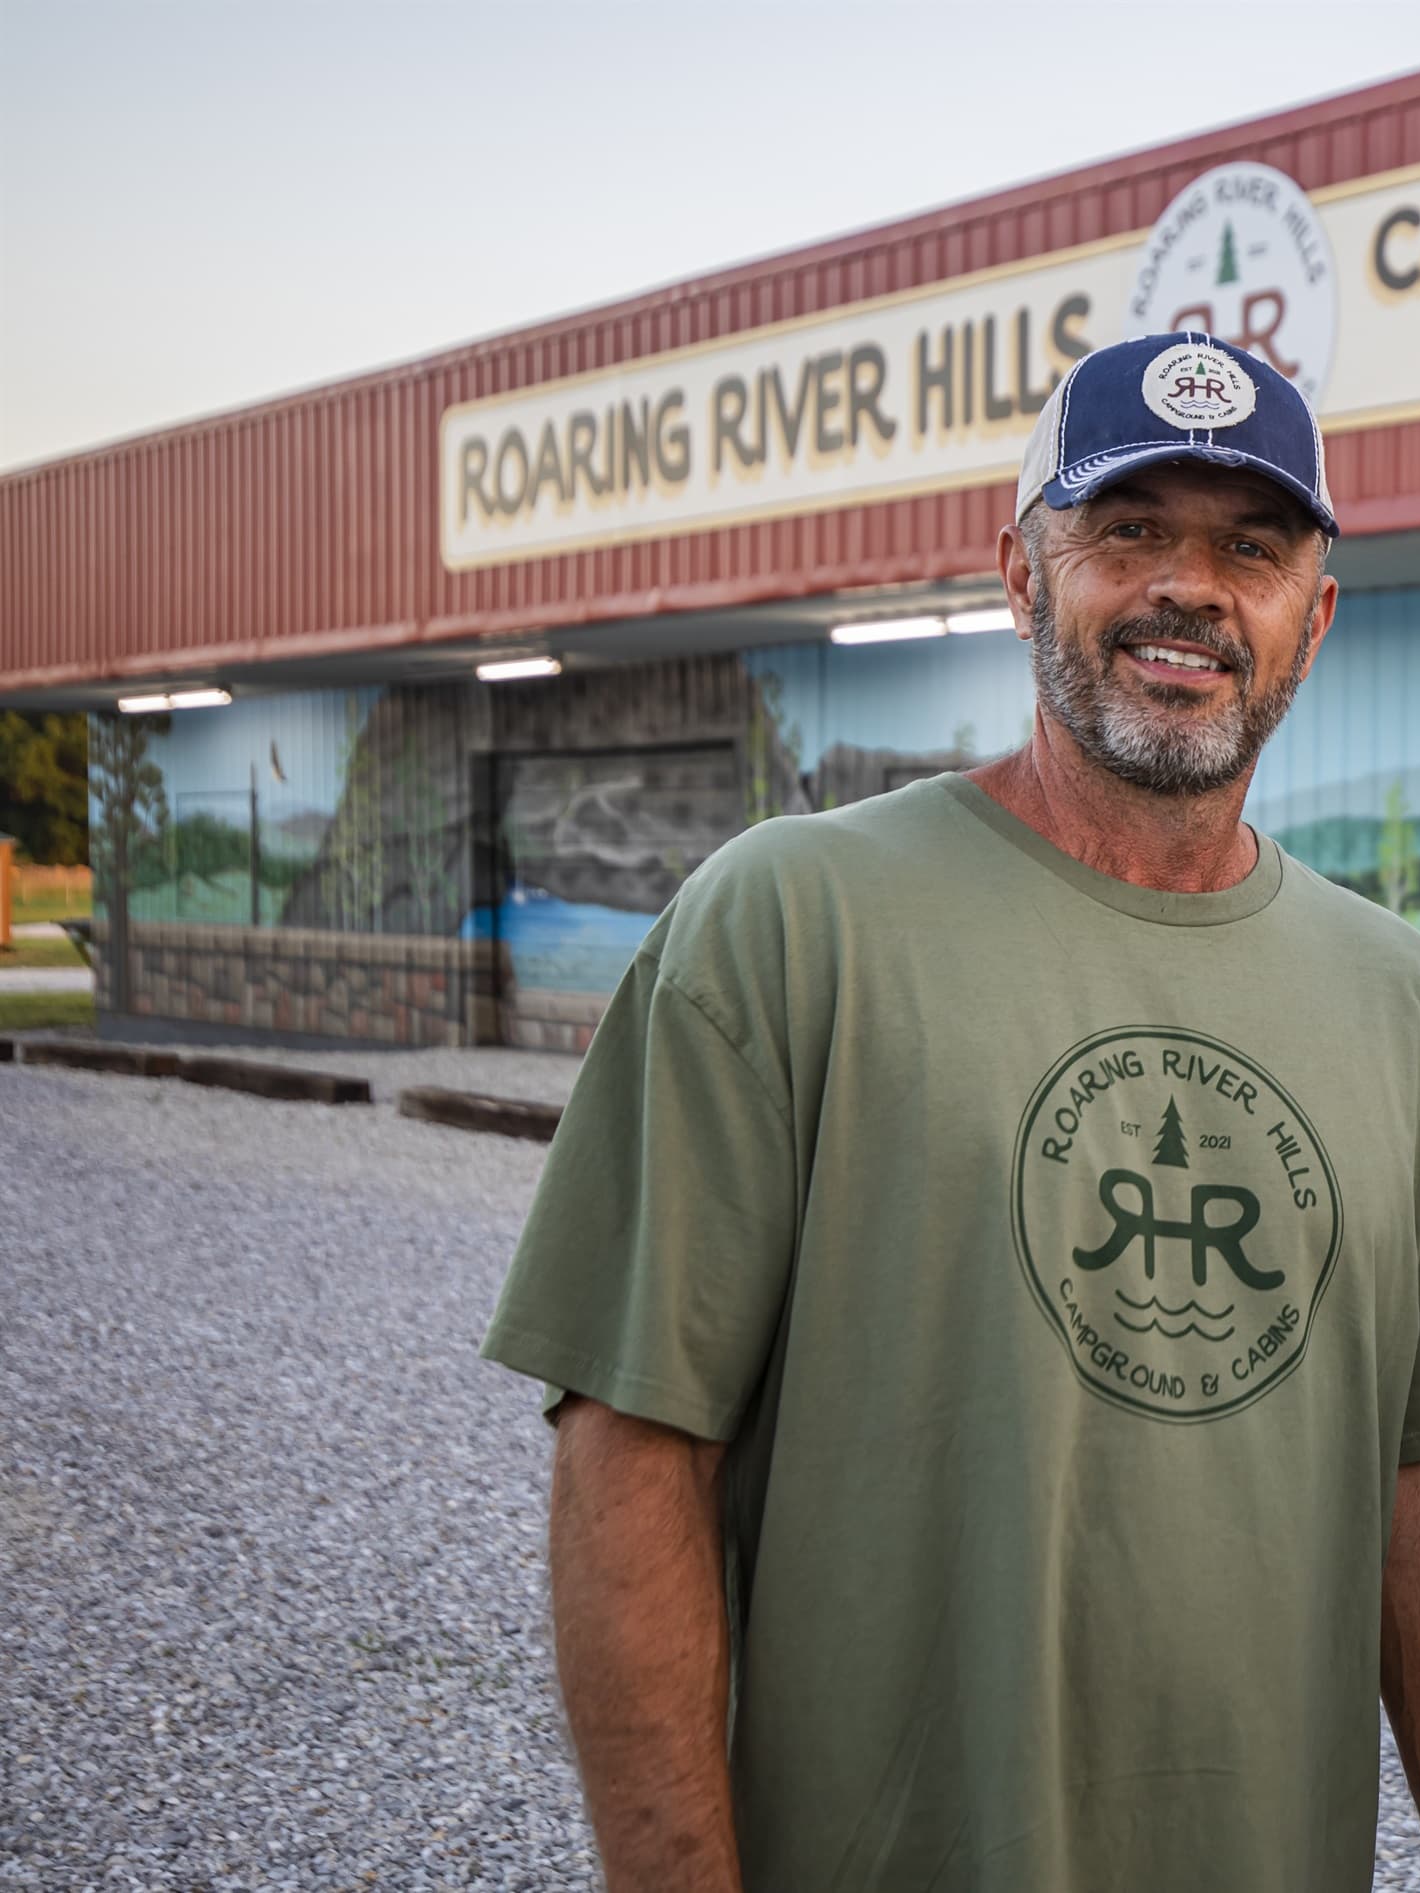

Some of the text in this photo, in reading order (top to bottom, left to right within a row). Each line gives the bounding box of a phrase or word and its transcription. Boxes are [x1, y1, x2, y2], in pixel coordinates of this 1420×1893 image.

[1133, 175, 1325, 317] ROARING RIVER HILLS
[462, 292, 1094, 522] ROARING RIVER HILLS
[1041, 1049, 1317, 1211] ROARING RIVER HILLS
[1120, 1120, 1232, 1150] EST 2021
[1058, 1278, 1301, 1400] CAMPGROUND & CABINS
